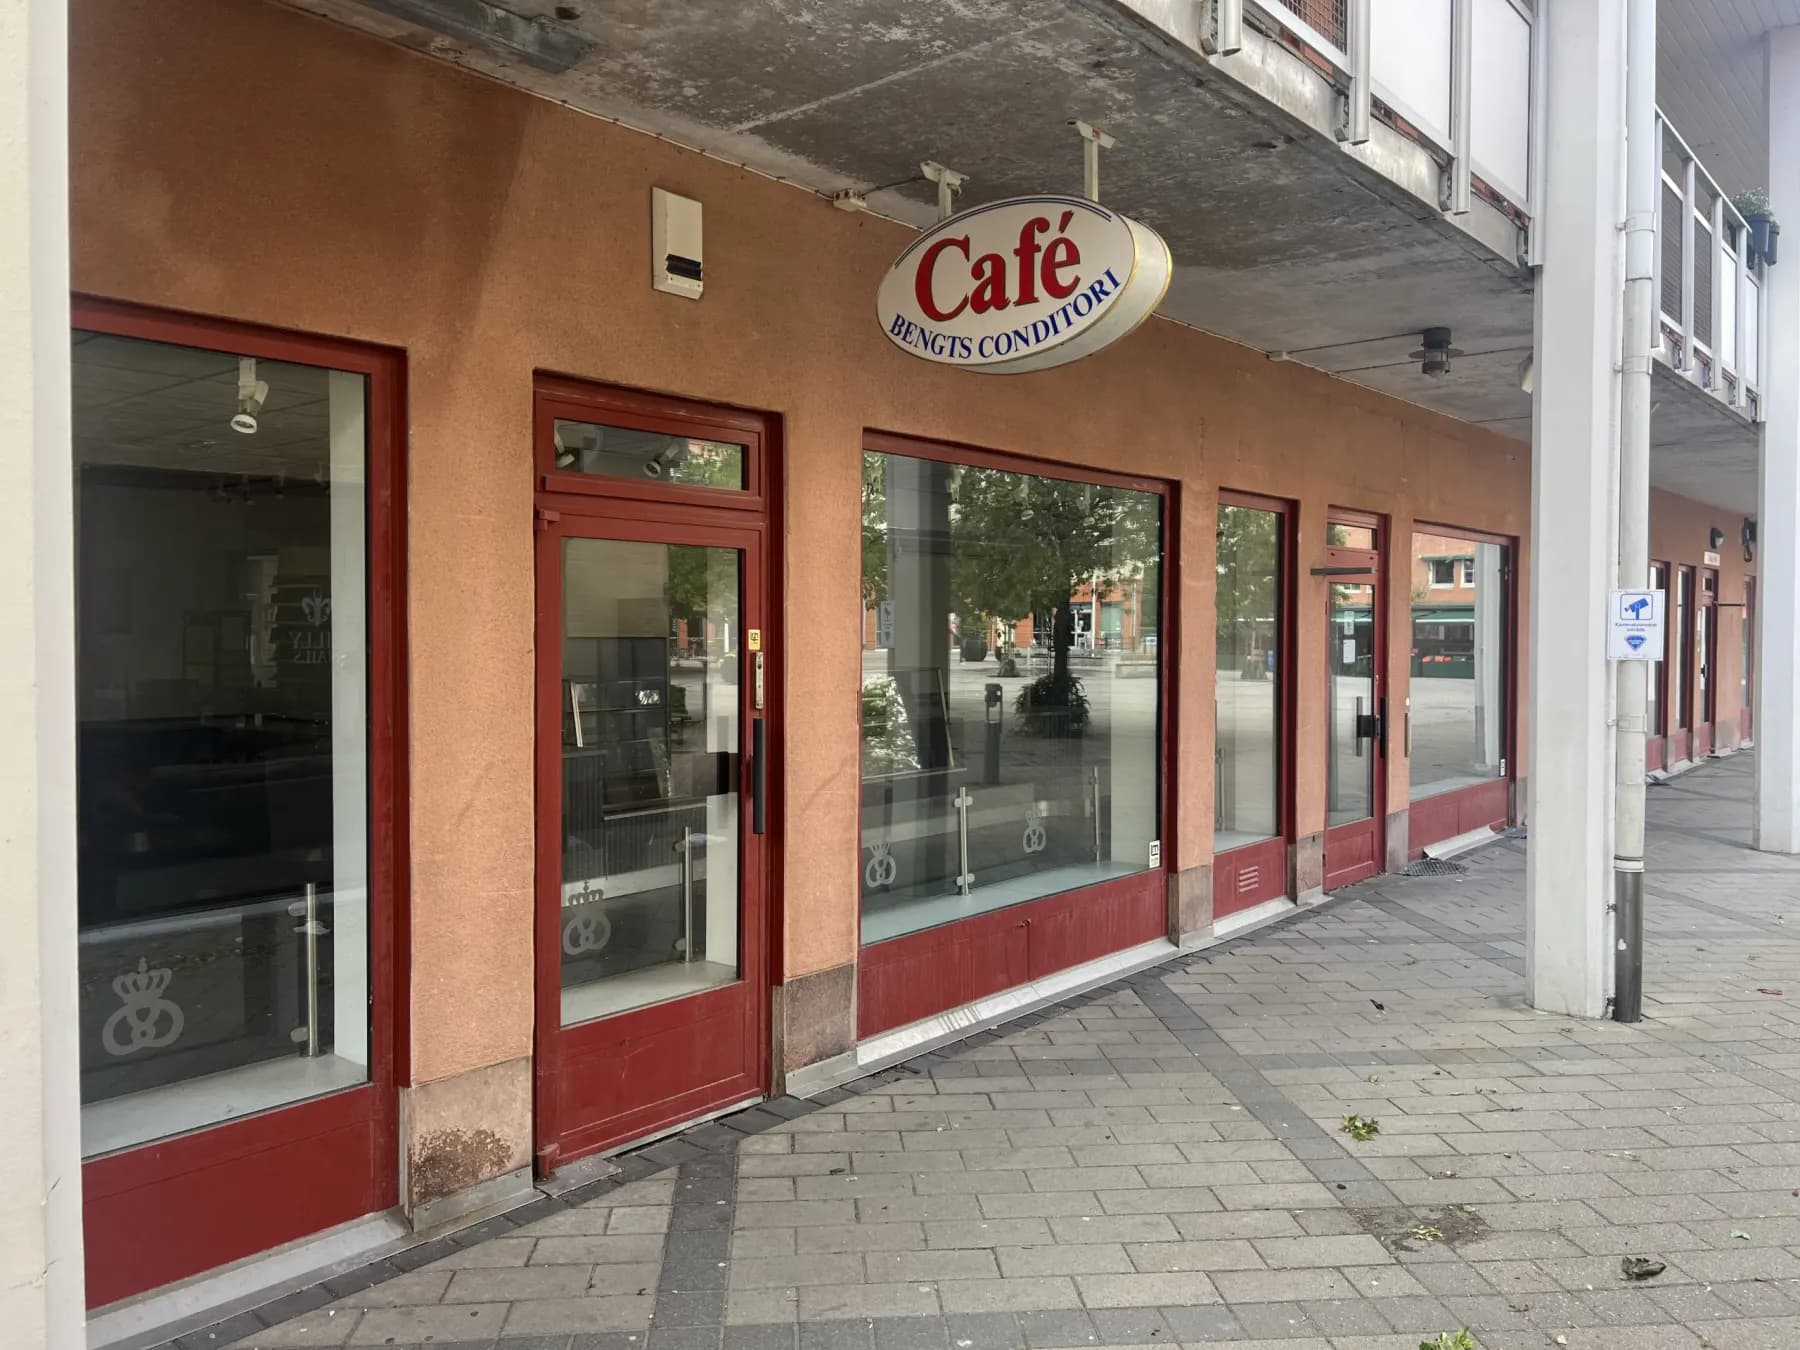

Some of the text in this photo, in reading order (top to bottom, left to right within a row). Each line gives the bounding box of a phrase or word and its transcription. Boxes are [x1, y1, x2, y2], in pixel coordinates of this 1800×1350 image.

[890, 267, 1121, 359] BENGTS CONDITORI
[915, 210, 1081, 322] Café
